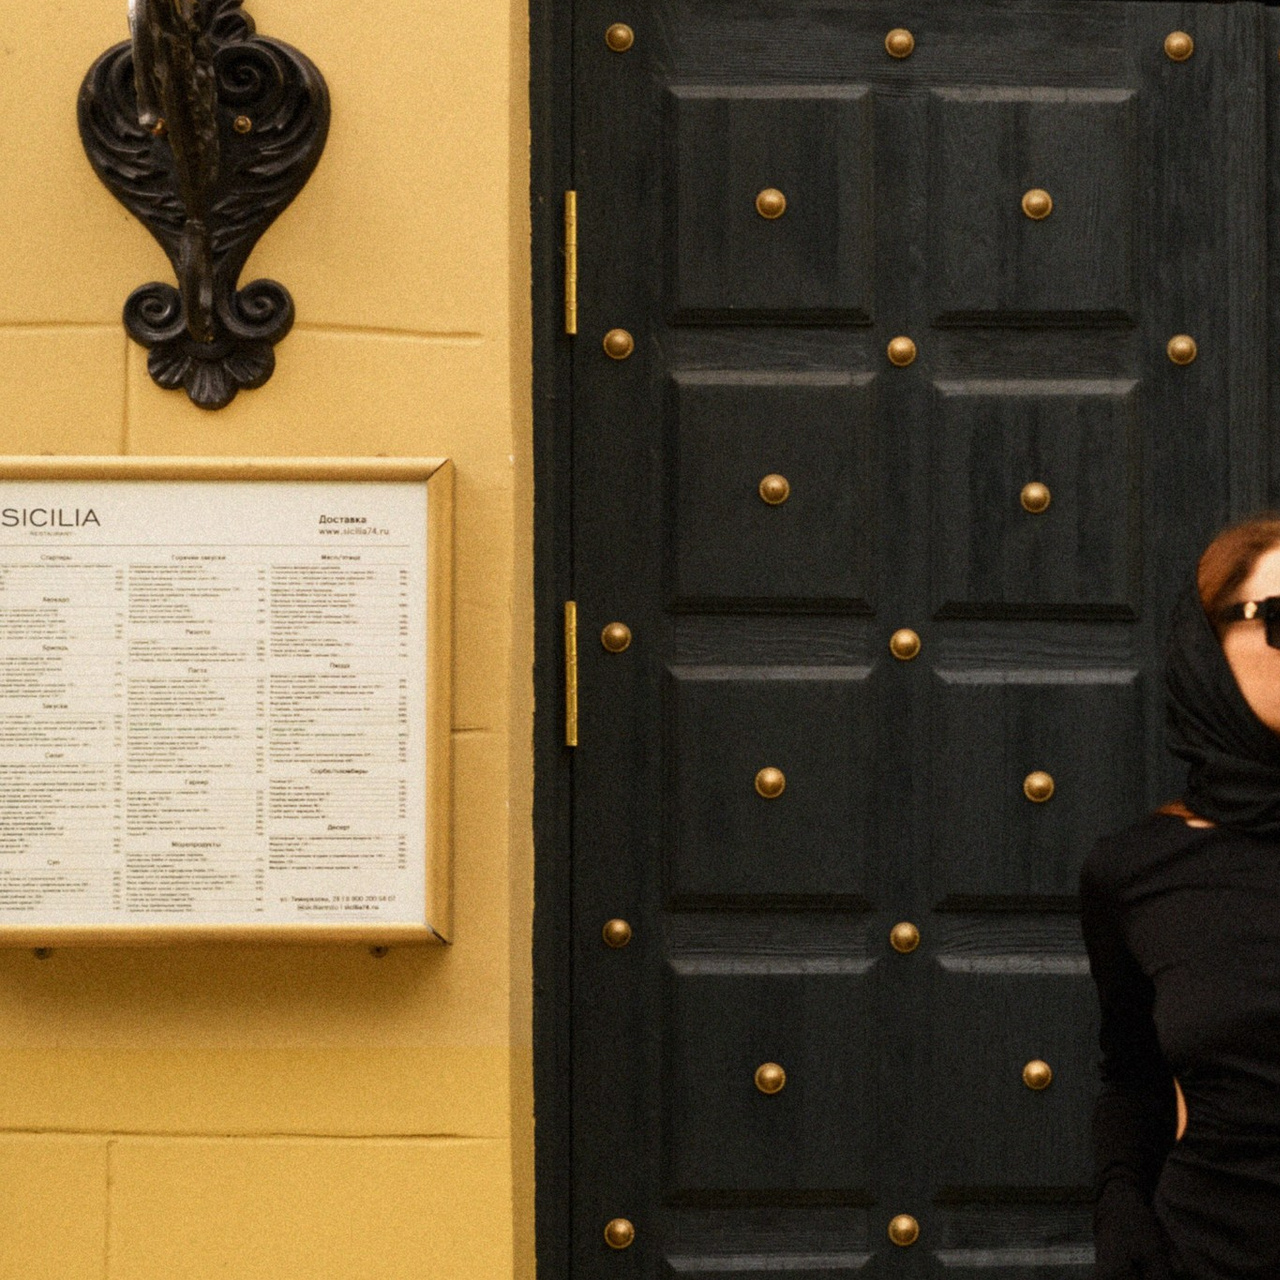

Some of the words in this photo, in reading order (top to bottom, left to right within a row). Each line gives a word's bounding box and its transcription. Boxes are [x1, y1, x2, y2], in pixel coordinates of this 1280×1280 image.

[1, 508, 101, 527] SICILIA
[319, 514, 367, 524] Доставка
[319, 527, 389, 536] www.sicilia74.ru
